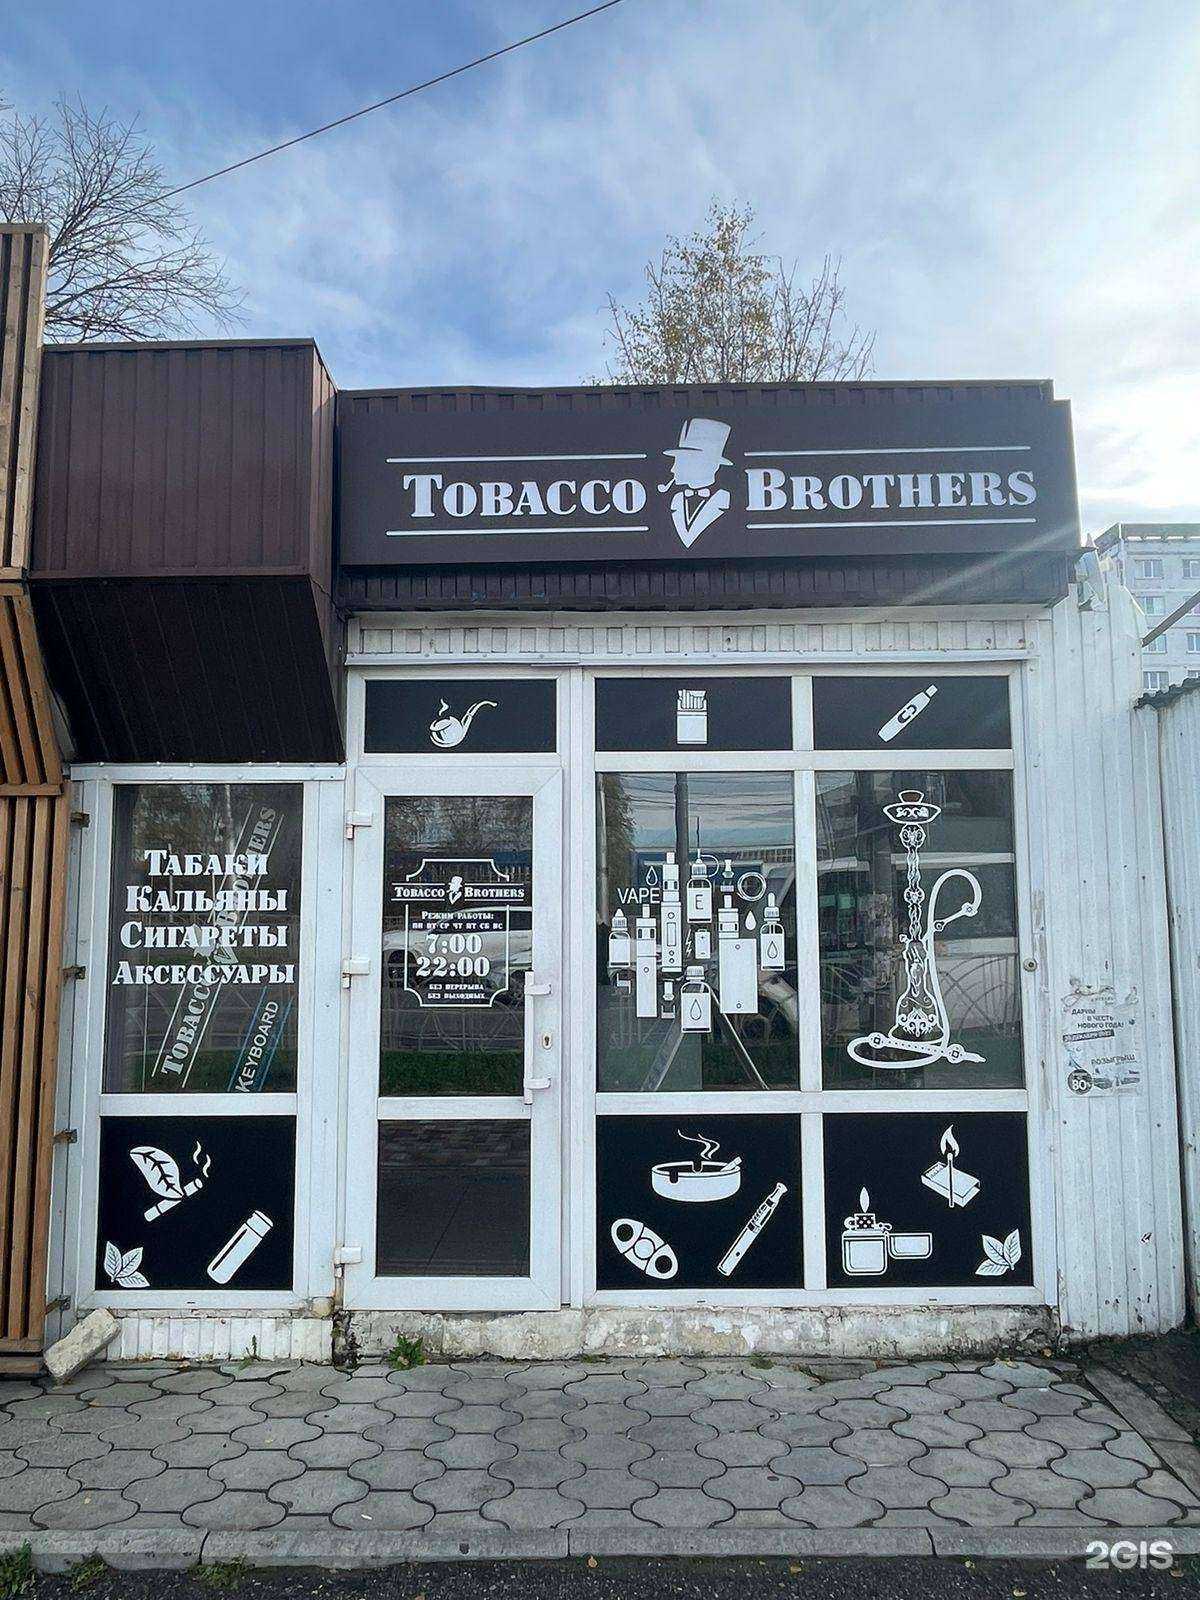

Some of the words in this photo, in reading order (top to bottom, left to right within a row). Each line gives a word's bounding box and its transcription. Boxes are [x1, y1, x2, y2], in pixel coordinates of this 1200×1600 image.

[403, 473, 648, 518] TOBACCO
[744, 467, 1038, 513] BROTHERS
[144, 849, 269, 877] ТАБАКИ
[125, 885, 288, 912] КАЛЬЯНЫ
[394, 886, 445, 898] TOBACCO
[464, 886, 525, 898] BROTHERS
[617, 887, 661, 904] VAPE
[421, 911, 454, 920] РЕЖИМ
[457, 912, 494, 920] РАБОТЫ:
[120, 921, 288, 949] СИГАРЕТЫ
[427, 934, 482, 954] 7:00
[112, 960, 296, 986] АКСЕССУАРЫ
[416, 956, 491, 977] 22:00
[444, 992, 486, 1000] ВЫХОДНЫХ
[1077, 1021, 1104, 1029] НОВОГО
[235, 1001, 279, 1092] KEYBOARD
